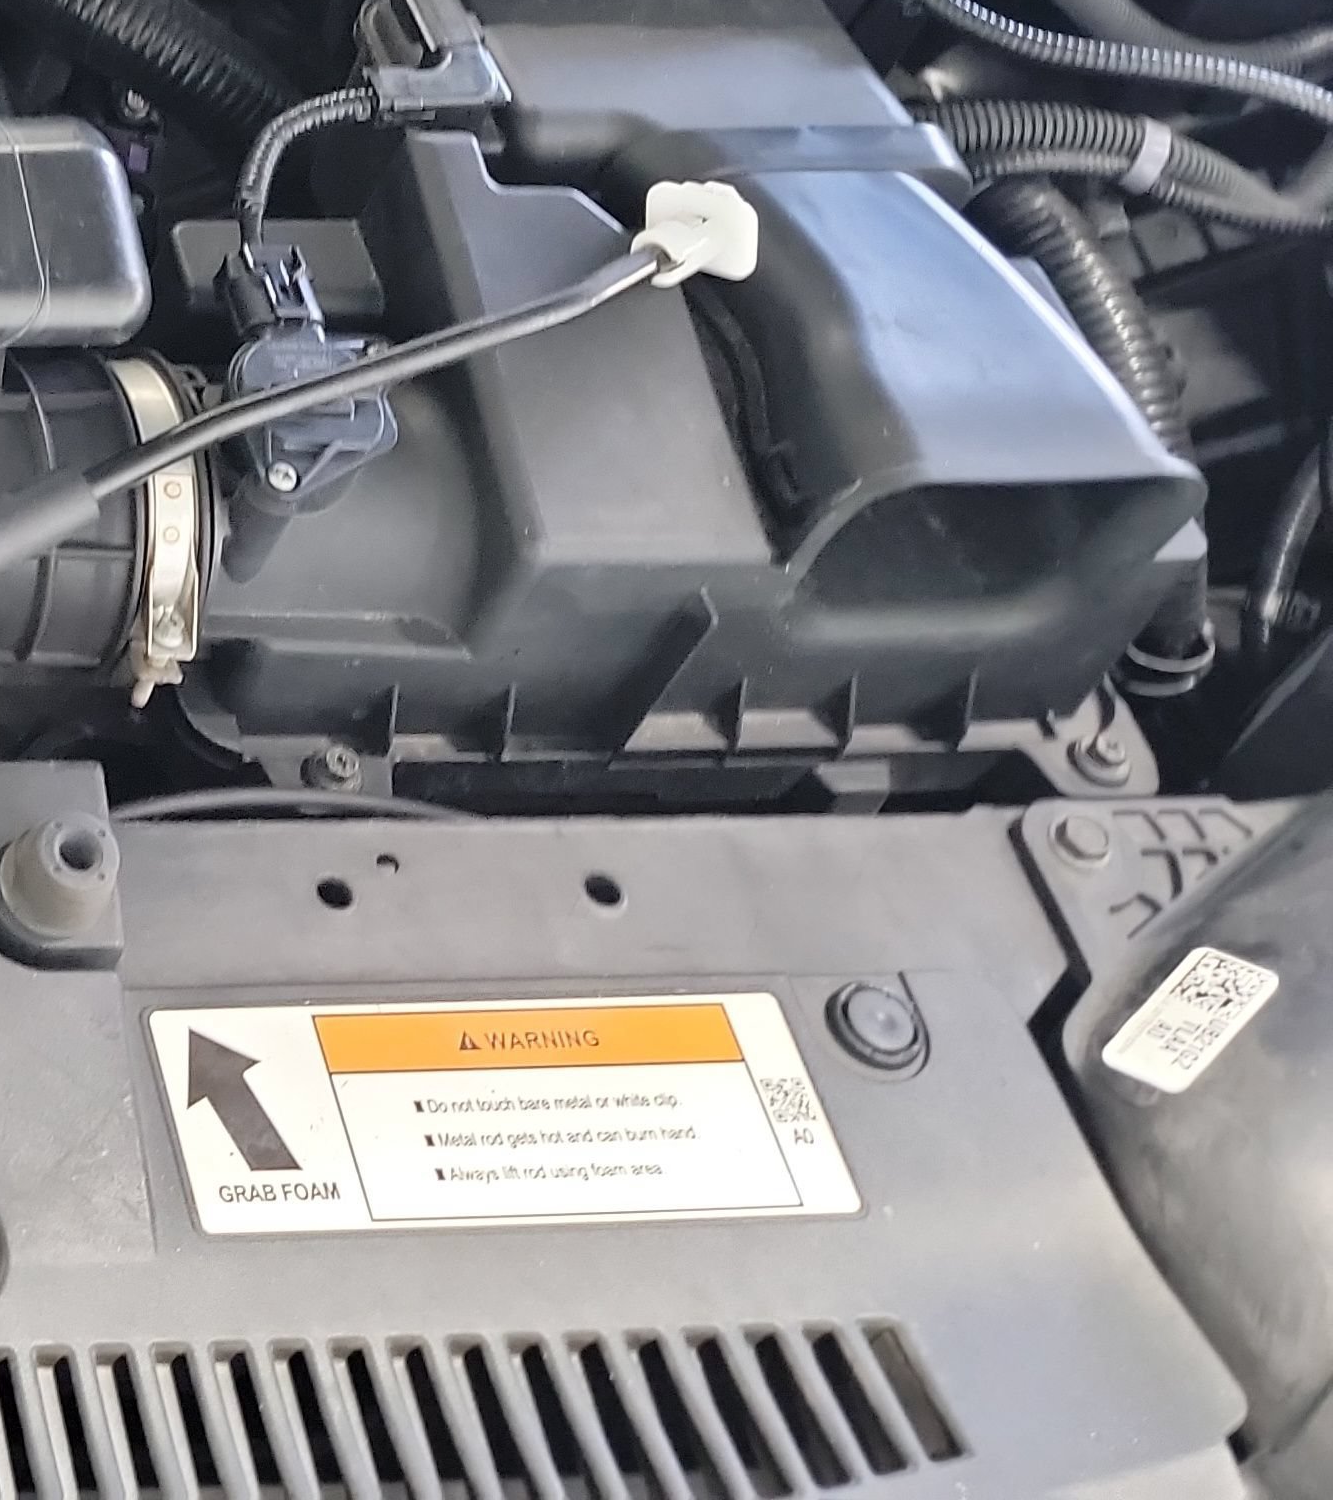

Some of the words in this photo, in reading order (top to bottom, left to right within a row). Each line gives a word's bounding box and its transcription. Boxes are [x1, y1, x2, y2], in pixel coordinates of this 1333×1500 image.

[484, 1030, 600, 1050] WARNING
[426, 1099, 448, 1113] Do
[451, 1099, 474, 1113] not
[476, 1097, 515, 1112] touch
[517, 1096, 550, 1110] bare
[553, 1094, 593, 1109] metal
[595, 1096, 609, 1109] or
[612, 1093, 651, 1108] white
[437, 1132, 477, 1147] Metal
[480, 1132, 504, 1146] rod
[507, 1132, 538, 1149] gets
[540, 1130, 564, 1144] hot
[566, 1129, 594, 1143] and
[596, 1129, 623, 1143] can
[624, 1127, 658, 1141] burn
[450, 1167, 500, 1184] Always
[502, 1165, 521, 1180] lift
[523, 1165, 546, 1180] rod
[550, 1165, 589, 1181] using
[590, 1162, 627, 1177] foam
[218, 1183, 277, 1203] GRAB
[281, 1181, 341, 1202] FOAM
